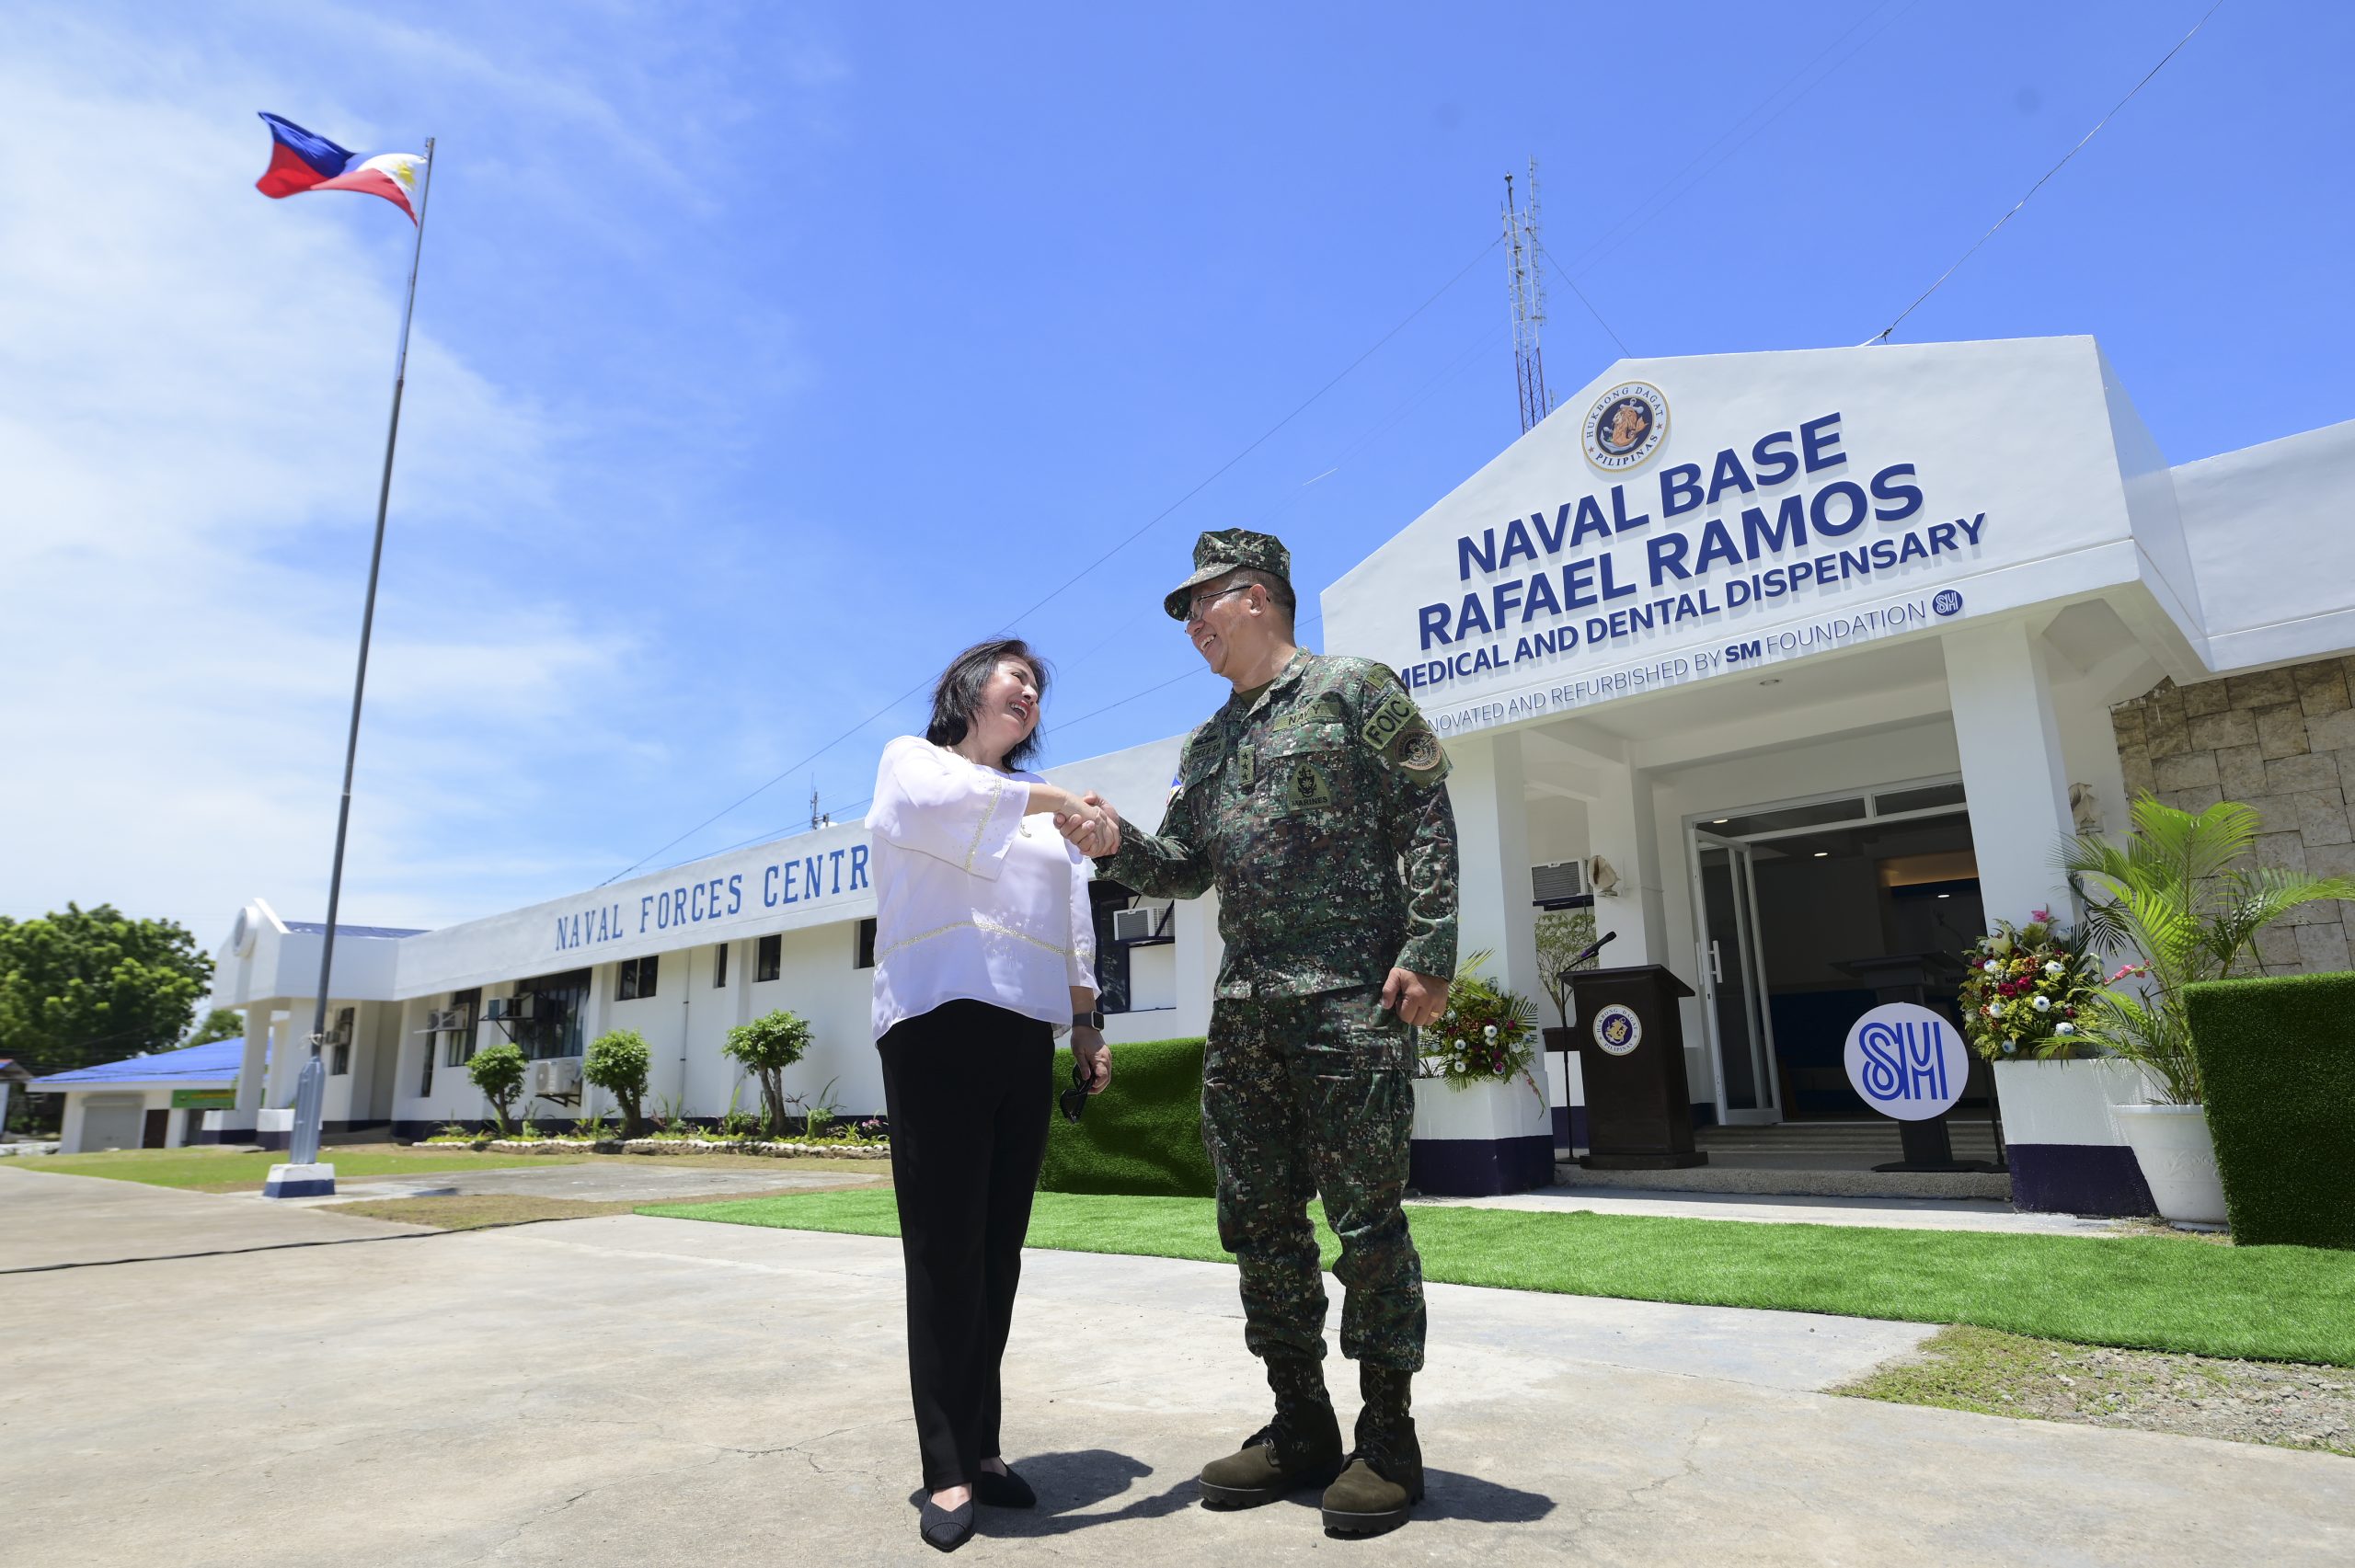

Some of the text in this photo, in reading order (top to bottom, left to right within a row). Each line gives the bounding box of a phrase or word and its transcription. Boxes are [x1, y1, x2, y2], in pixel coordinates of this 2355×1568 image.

[1586, 386, 1663, 438] HUKBONG DAGAT
[1595, 434, 1658, 466] PILIPINAS
[1458, 411, 1847, 581] NAVAL BASE
[1419, 463, 1924, 650] RAFAEL RAMOS
[1514, 625, 1579, 663] AND
[1585, 589, 1720, 645] DENTAL
[1725, 512, 1986, 609] DISPENSARY
[1508, 692, 1546, 715] AND
[1551, 658, 1688, 704] REFURBISHED
[1694, 649, 1721, 671] BY
[1725, 639, 1761, 663] SM
[1766, 600, 1925, 654] FOUNDATION
[1935, 591, 1959, 614] SM
[1288, 704, 1321, 726] NAVY
[1291, 795, 1328, 807] MARINES
[556, 843, 869, 951] NAVAL FORCES CENTR
[1858, 1021, 1948, 1101] SM
